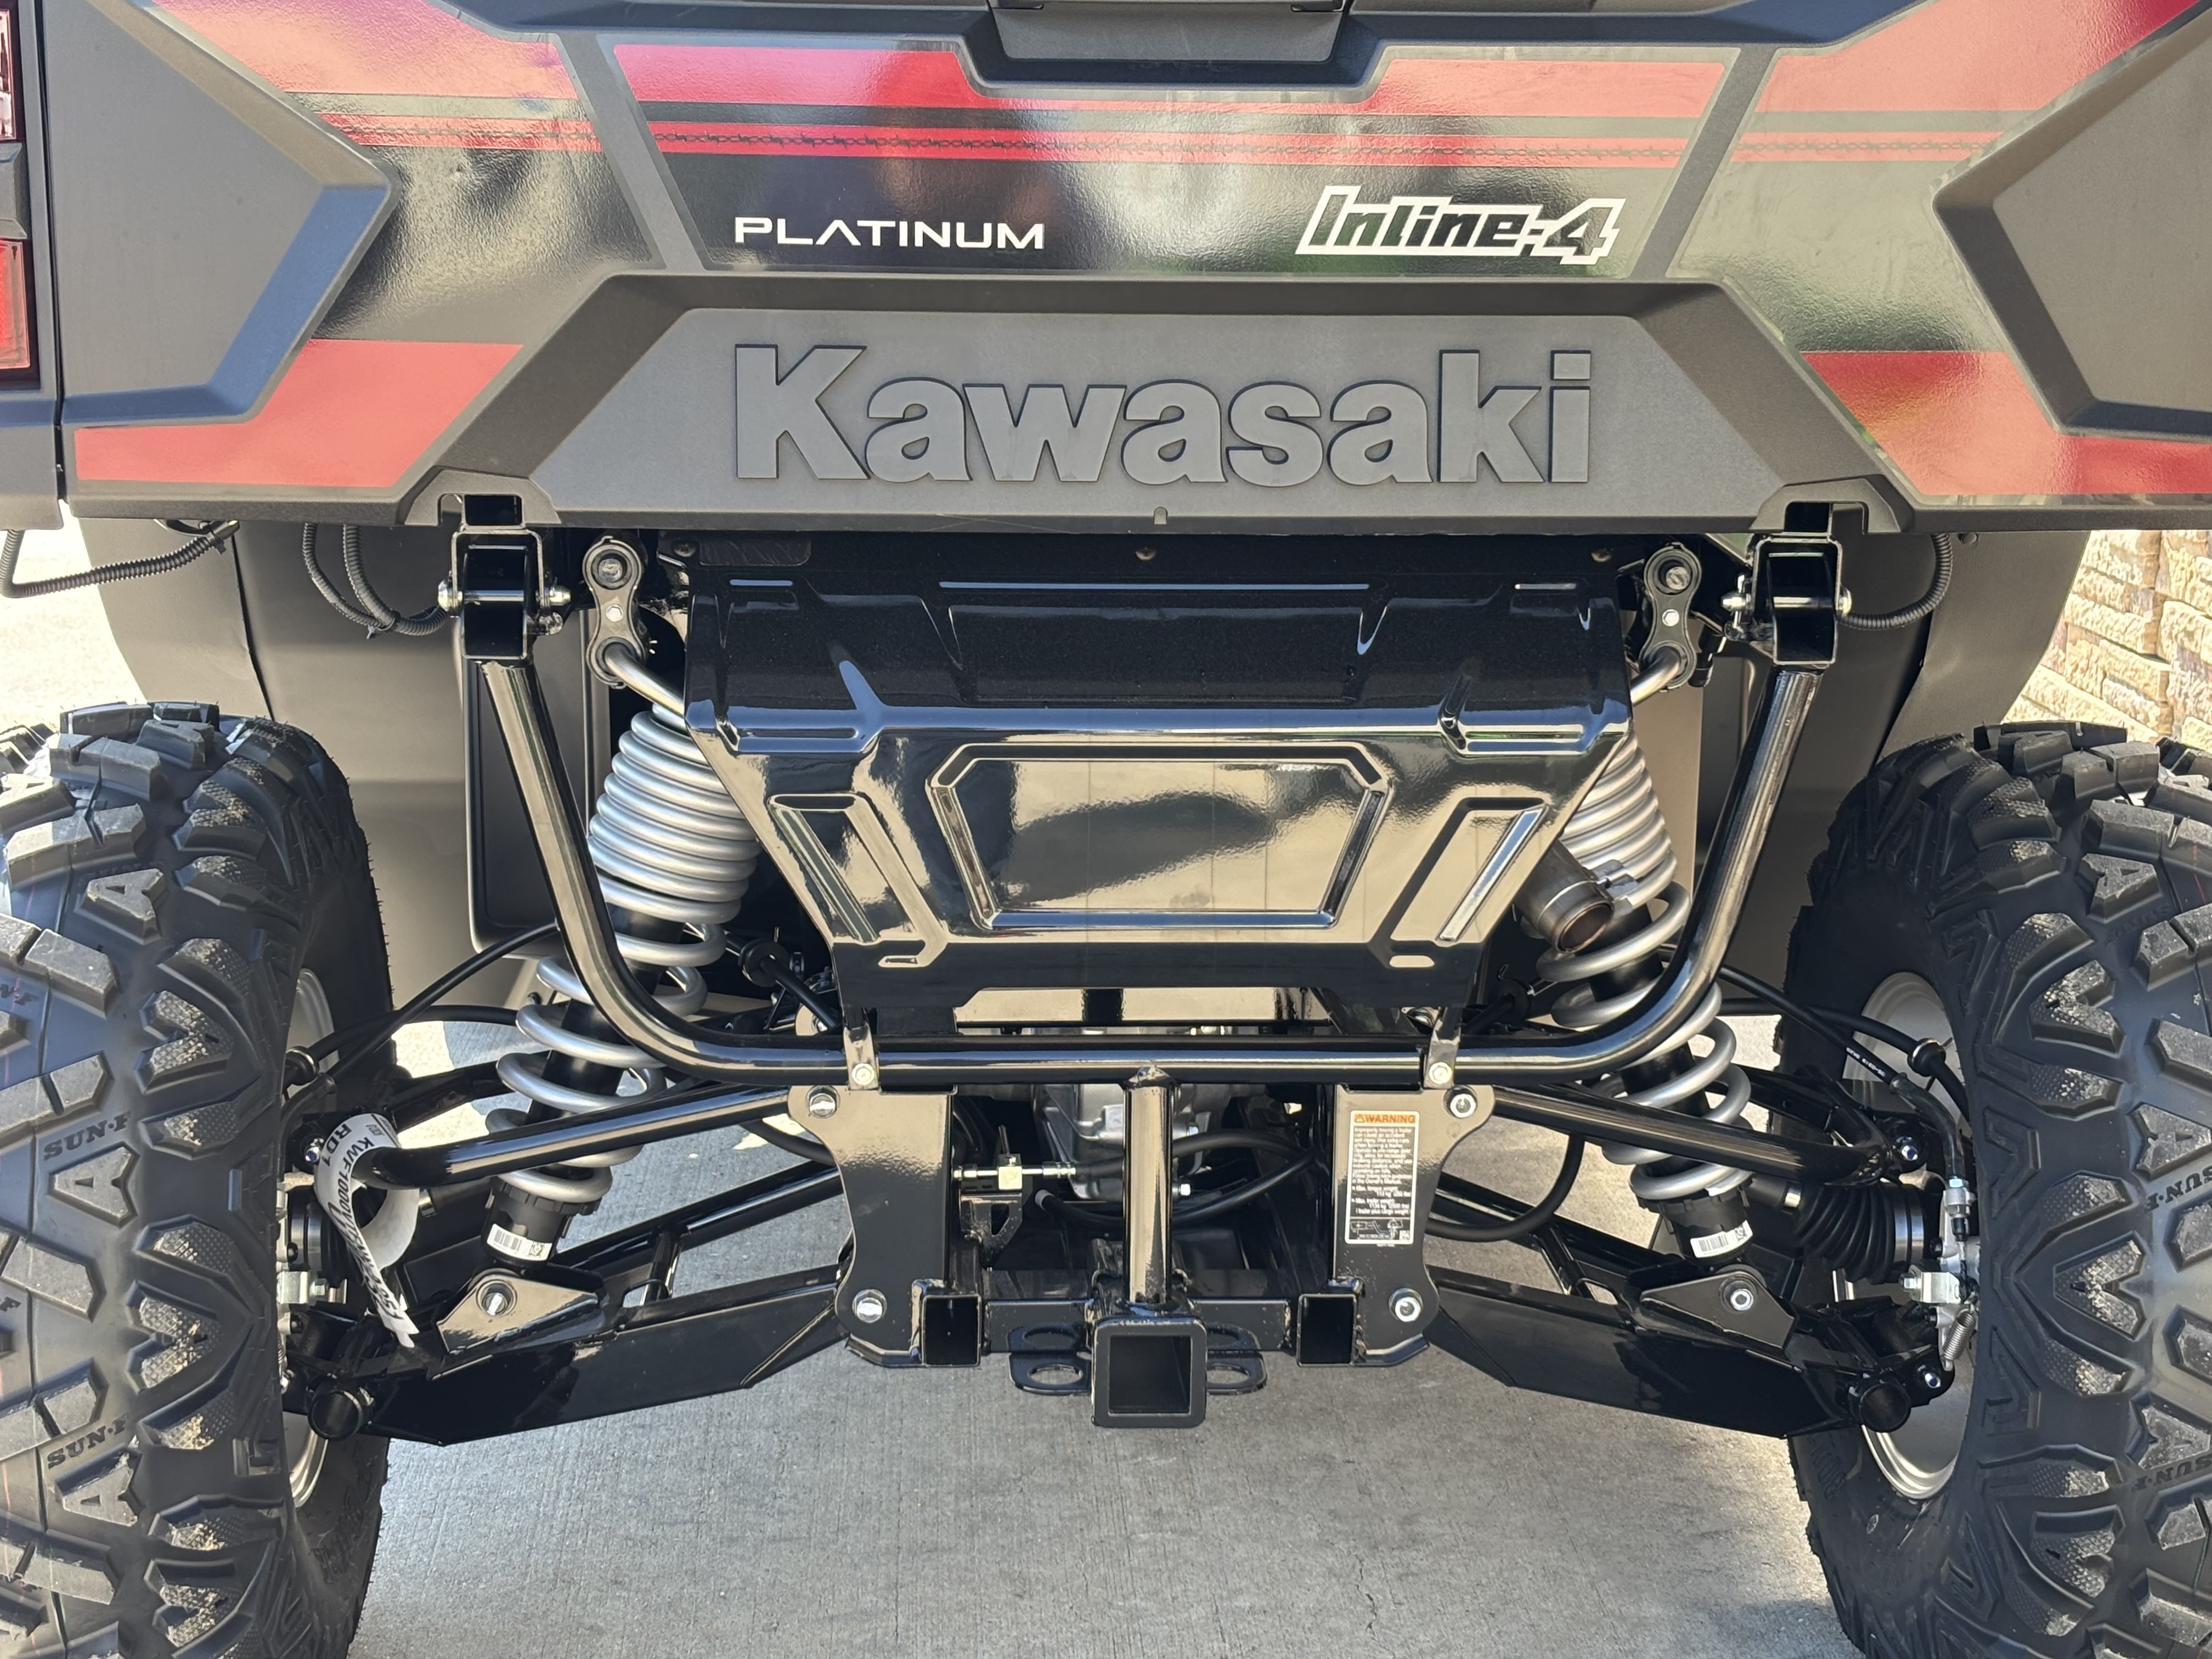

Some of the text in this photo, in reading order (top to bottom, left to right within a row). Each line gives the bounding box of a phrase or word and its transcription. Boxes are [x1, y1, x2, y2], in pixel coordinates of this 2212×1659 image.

[735, 217, 1045, 250] PLATINUM
[1295, 185, 1626, 265] Inline-4
[735, 343, 1593, 487] Kawasaki
[1365, 1114, 1415, 1123] WARNING
